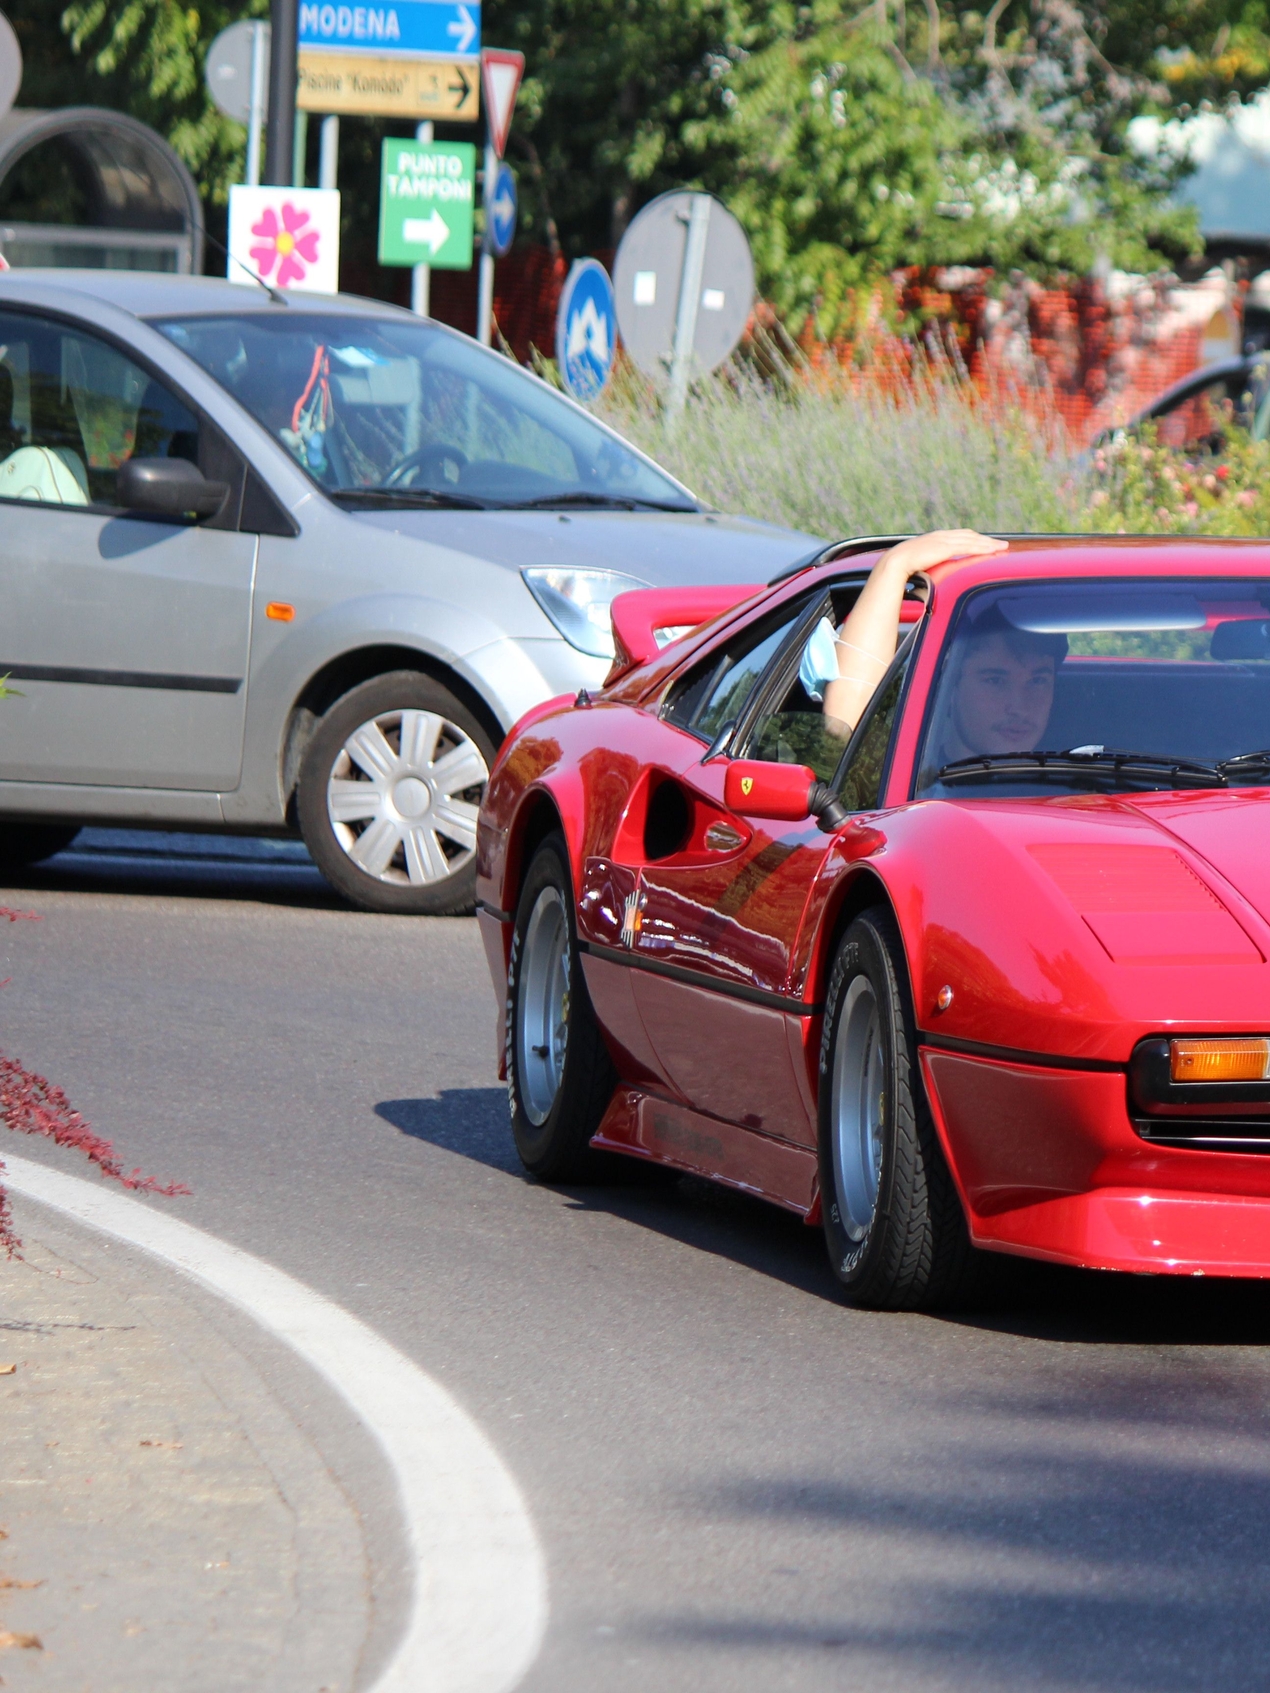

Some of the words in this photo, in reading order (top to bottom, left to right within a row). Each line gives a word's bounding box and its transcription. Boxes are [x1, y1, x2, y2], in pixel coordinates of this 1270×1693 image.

[300, 3, 400, 41] MODENA
[398, 151, 463, 178] PUNTO
[387, 174, 472, 201] TAMPONI
[819, 957, 845, 1075] PIRELLI
